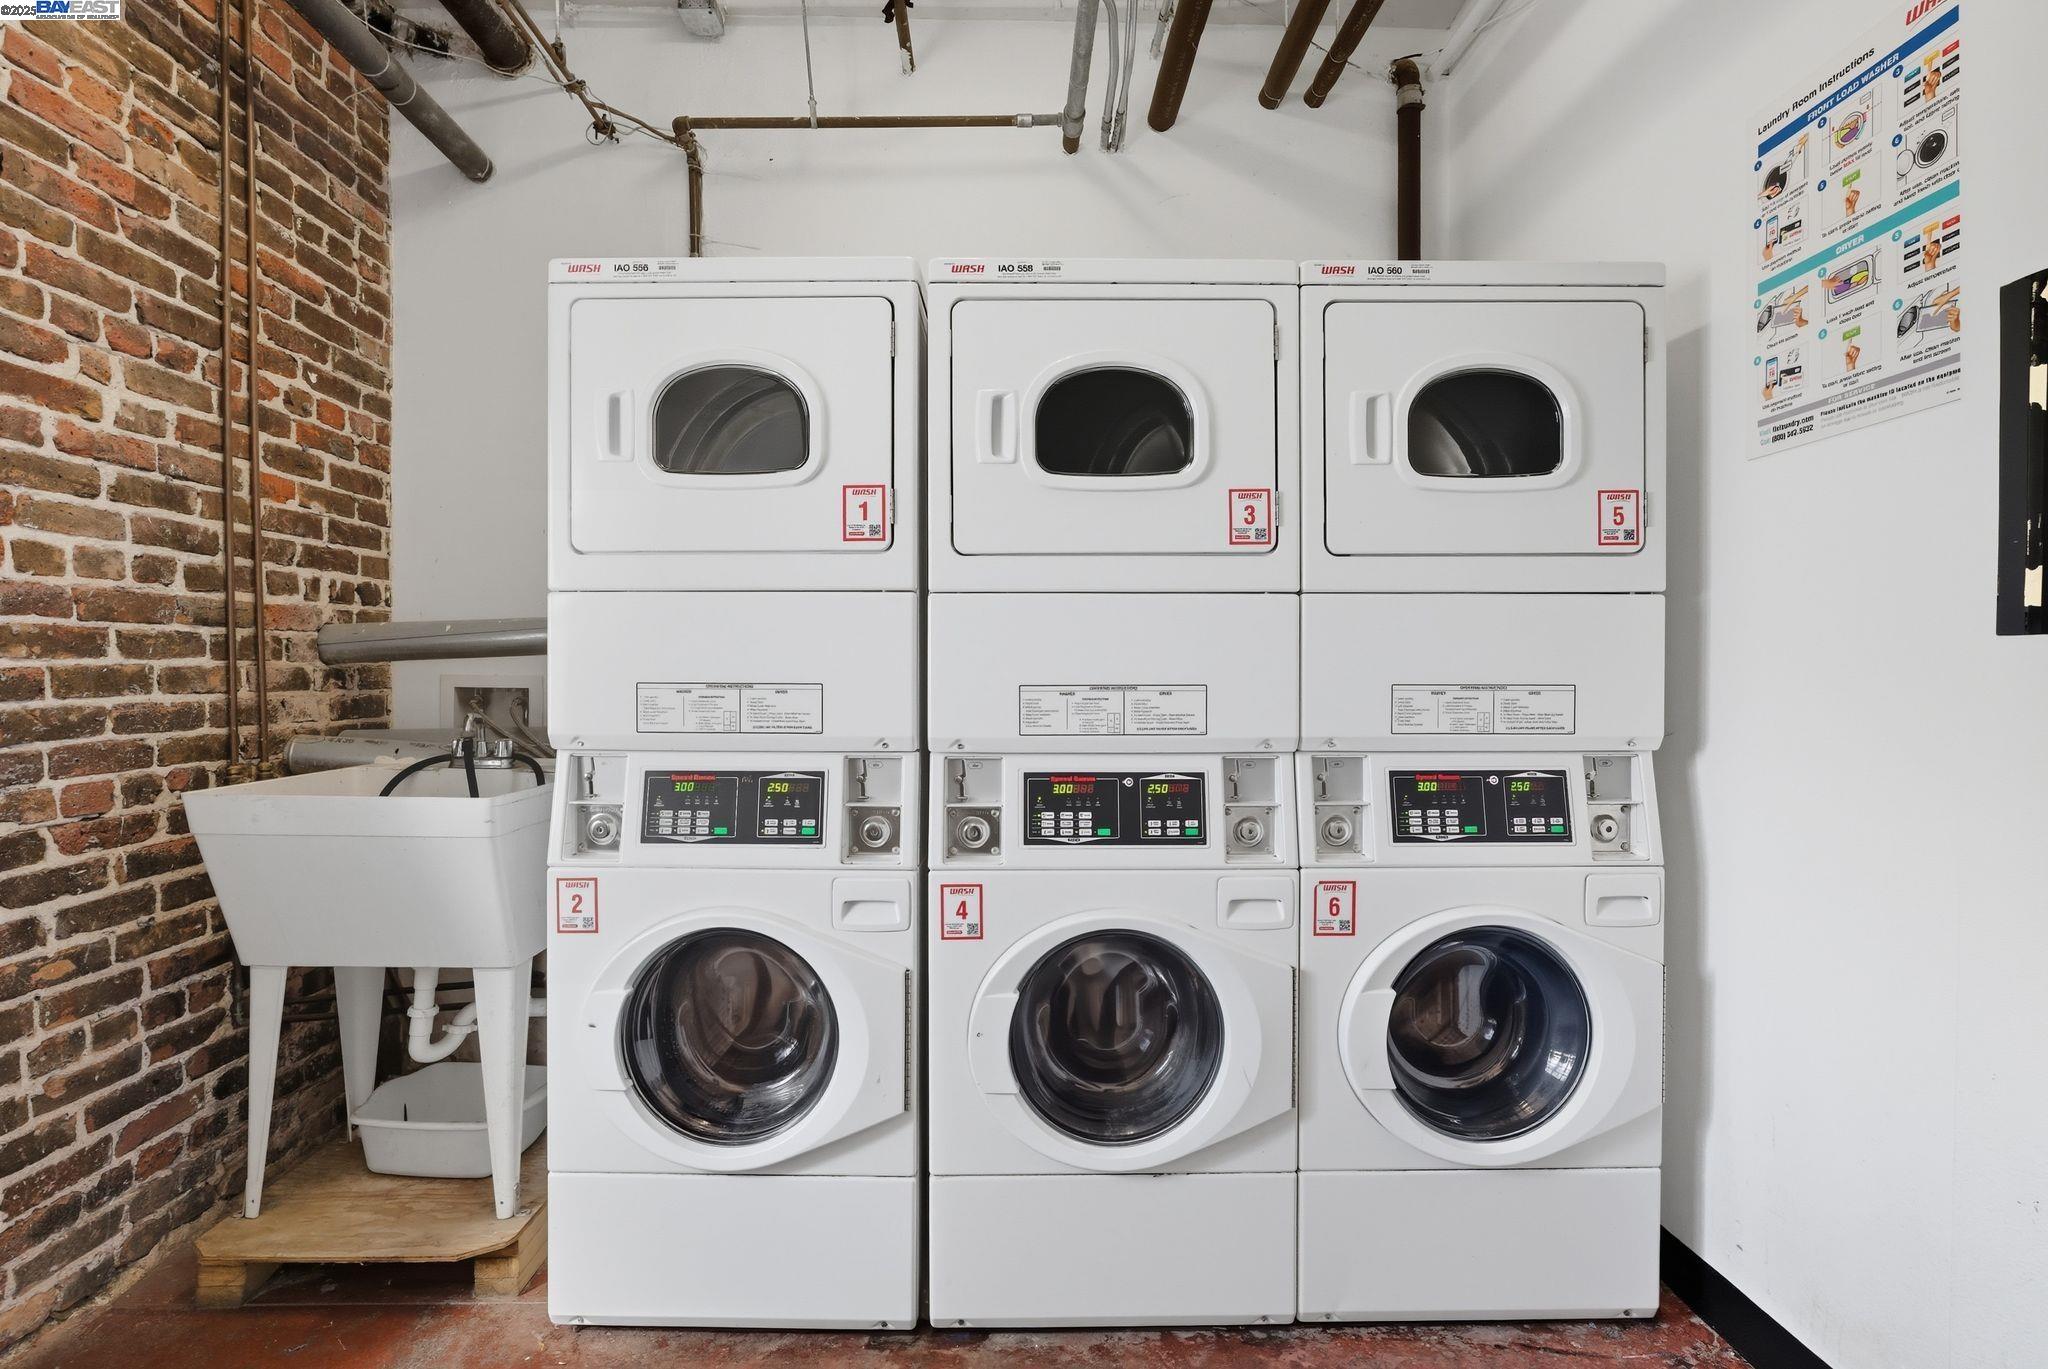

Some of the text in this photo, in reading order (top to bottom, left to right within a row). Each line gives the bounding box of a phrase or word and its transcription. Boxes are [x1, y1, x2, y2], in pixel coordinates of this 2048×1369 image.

[1758, 108, 1790, 135] Laundry
[1792, 89, 1817, 111] Room
[1819, 48, 1875, 92] Instructions
[1807, 97, 1835, 121] FRONT
[1836, 81, 1860, 102] LOAD
[1861, 53, 1899, 84] WASHER
[1835, 233, 1864, 255] DRYER
[568, 264, 601, 273] WASH
[951, 264, 985, 273] WASH
[1321, 266, 1355, 275] WASH
[1238, 492, 1262, 500] WASH
[858, 501, 868, 521] 1
[1243, 504, 1256, 526] 3
[1612, 506, 1625, 526] 5
[571, 894, 583, 914] 2
[955, 900, 968, 920] 4
[1329, 897, 1341, 917] 6
